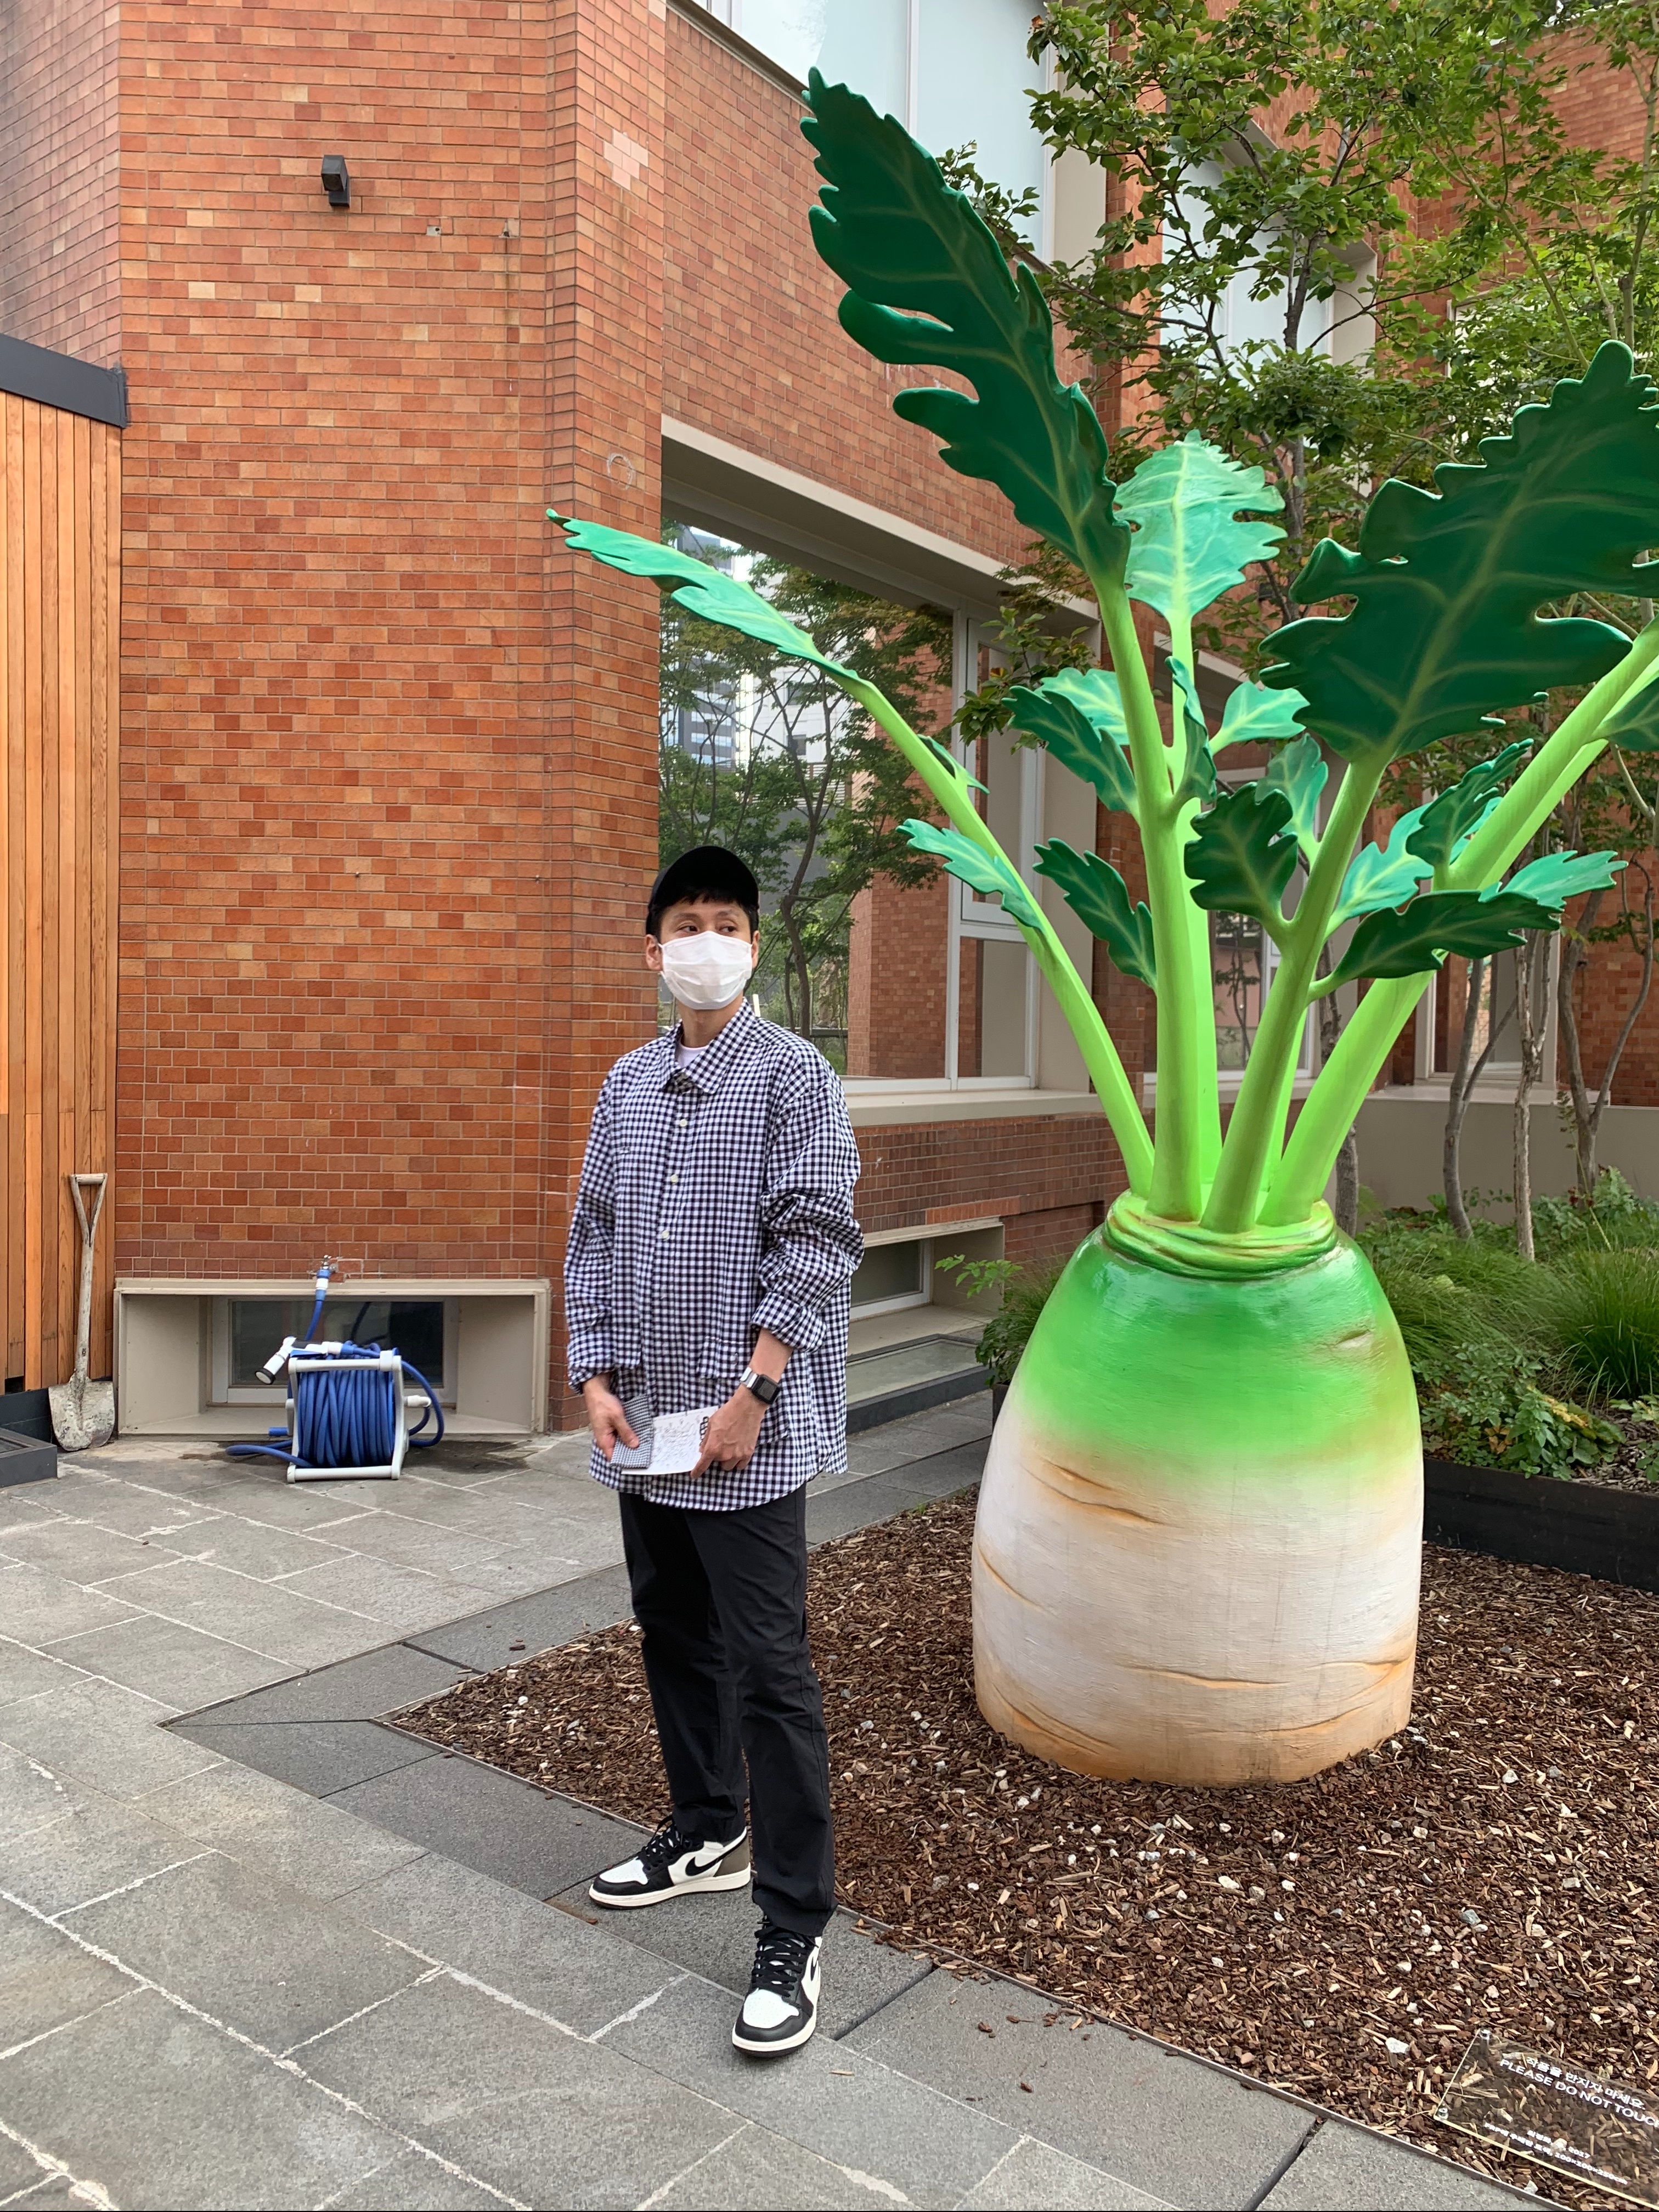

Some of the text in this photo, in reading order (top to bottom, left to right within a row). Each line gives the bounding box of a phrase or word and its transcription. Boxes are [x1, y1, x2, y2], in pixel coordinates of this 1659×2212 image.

[1499, 2058, 1554, 2086] PLEASE
[1555, 2081, 1578, 2096] DO
[1579, 2090, 1613, 2109] NOT
[1526, 2056, 1646, 2111] 작품을 만지지 마세요.
[1568, 2146, 1591, 2159] 2017
